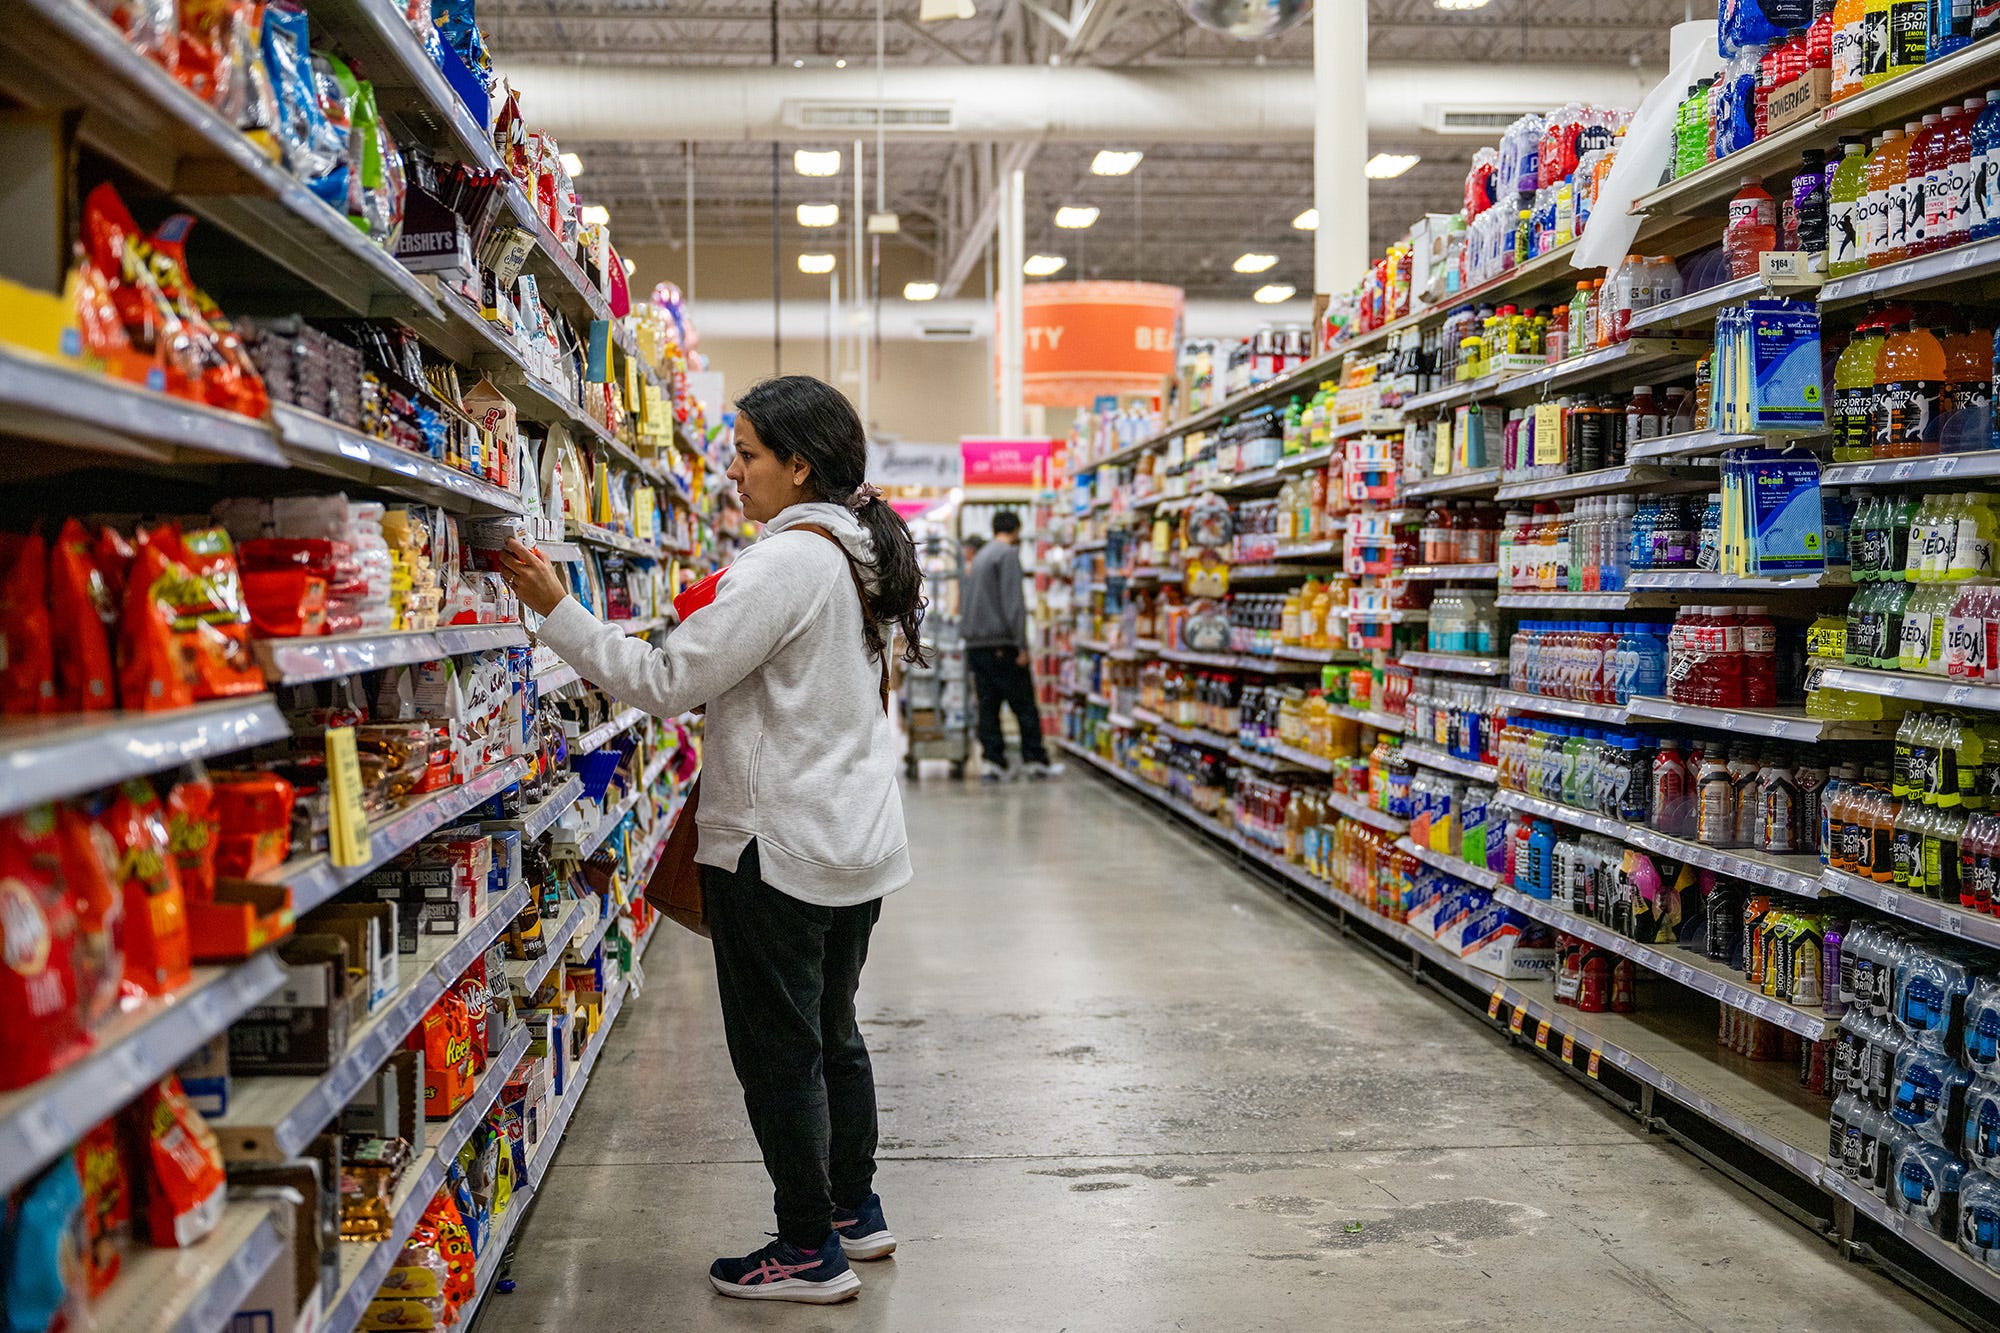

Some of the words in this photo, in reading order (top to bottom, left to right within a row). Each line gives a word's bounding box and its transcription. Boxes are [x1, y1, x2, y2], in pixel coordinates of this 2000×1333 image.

[1769, 82, 1810, 121] POWERADE
[400, 231, 454, 252] ERSHEY'S
[1135, 326, 1174, 350] BEA
[1757, 327, 1783, 336] Clean
[1808, 387, 1816, 396] 4
[1758, 476, 1784, 485] Clean
[1808, 534, 1816, 542] 4
[1805, 792, 1813, 843] BODYARMOR
[409, 871, 451, 884] HERSHEY'S
